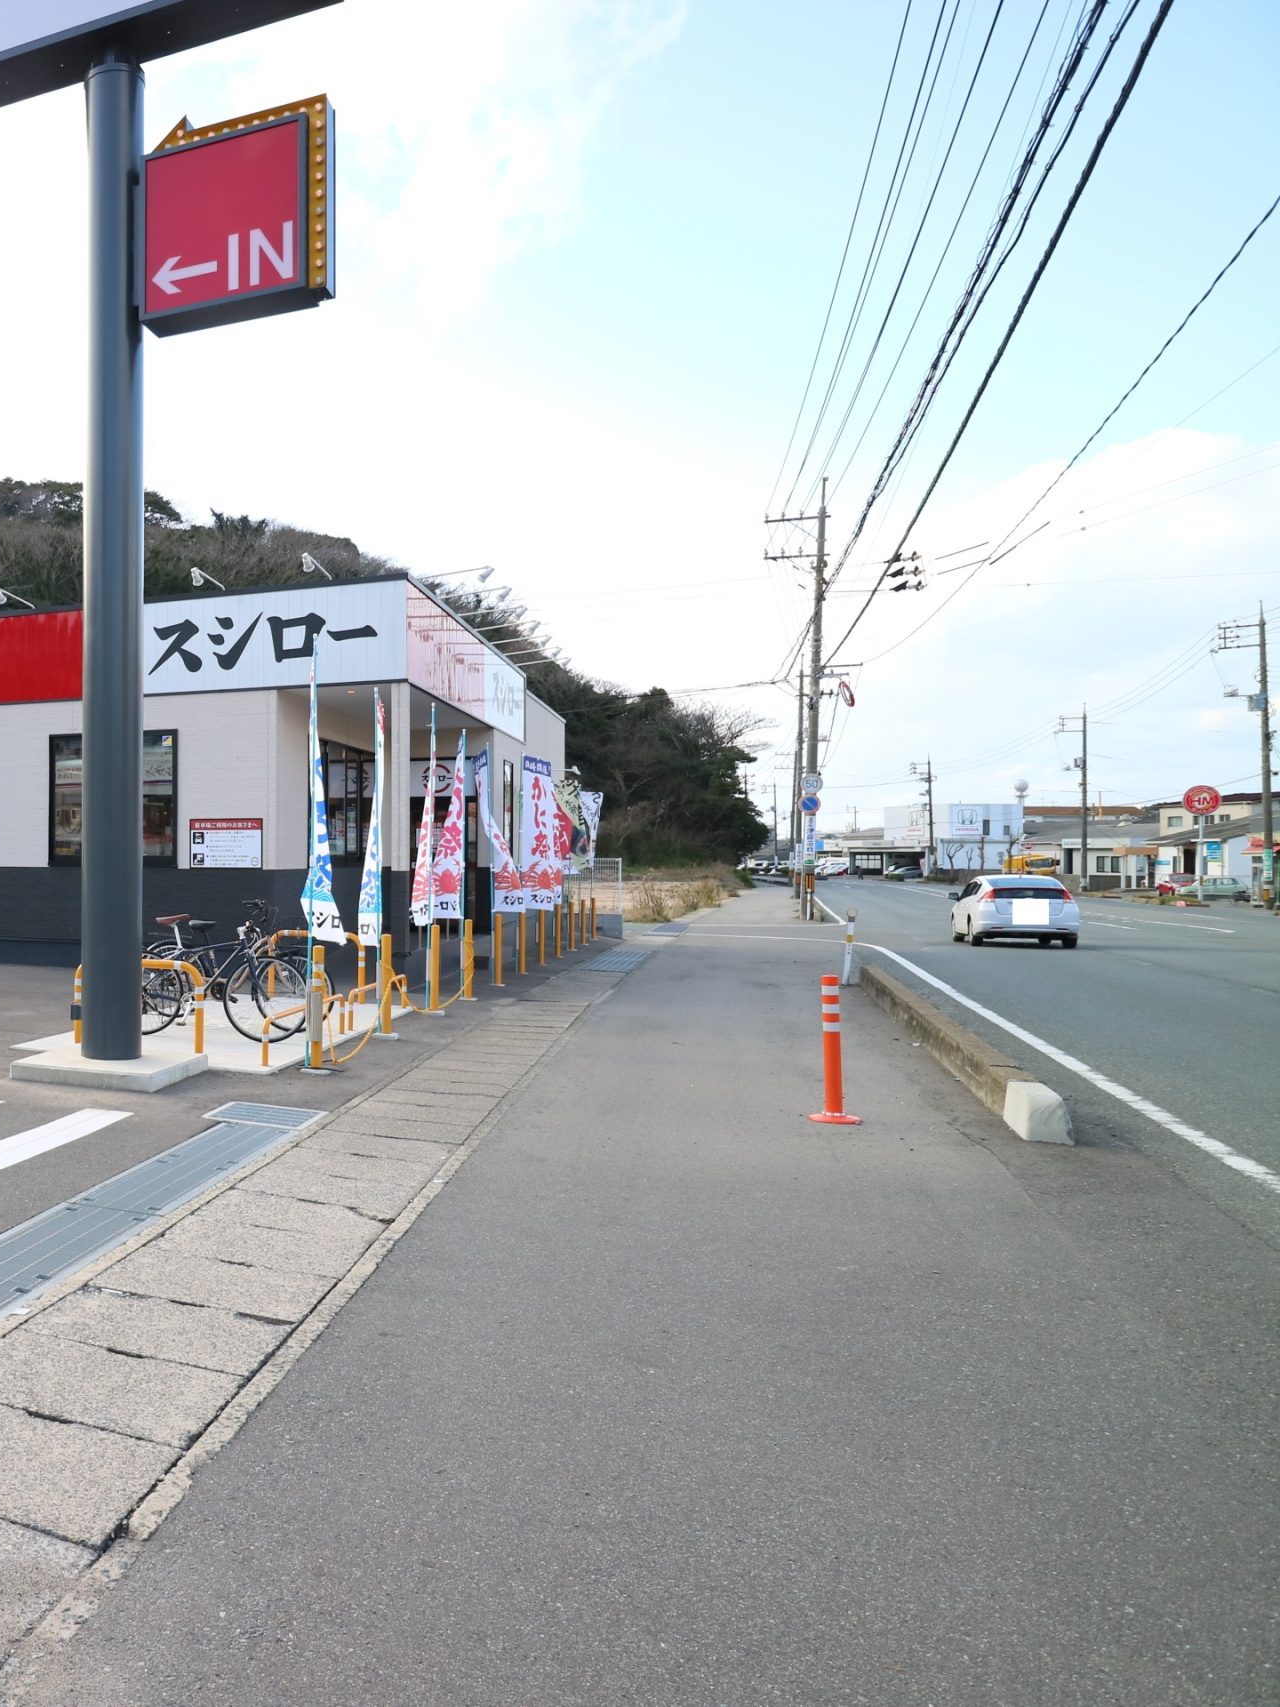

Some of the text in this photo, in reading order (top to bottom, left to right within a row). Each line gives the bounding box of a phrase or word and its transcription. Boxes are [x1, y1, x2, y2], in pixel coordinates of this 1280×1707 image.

[227, 220, 294, 292] IN
[148, 611, 378, 676] スシロー
[421, 775, 453, 783] スロー
[805, 780, 818, 788] 50
[1189, 796, 1216, 806] HM
